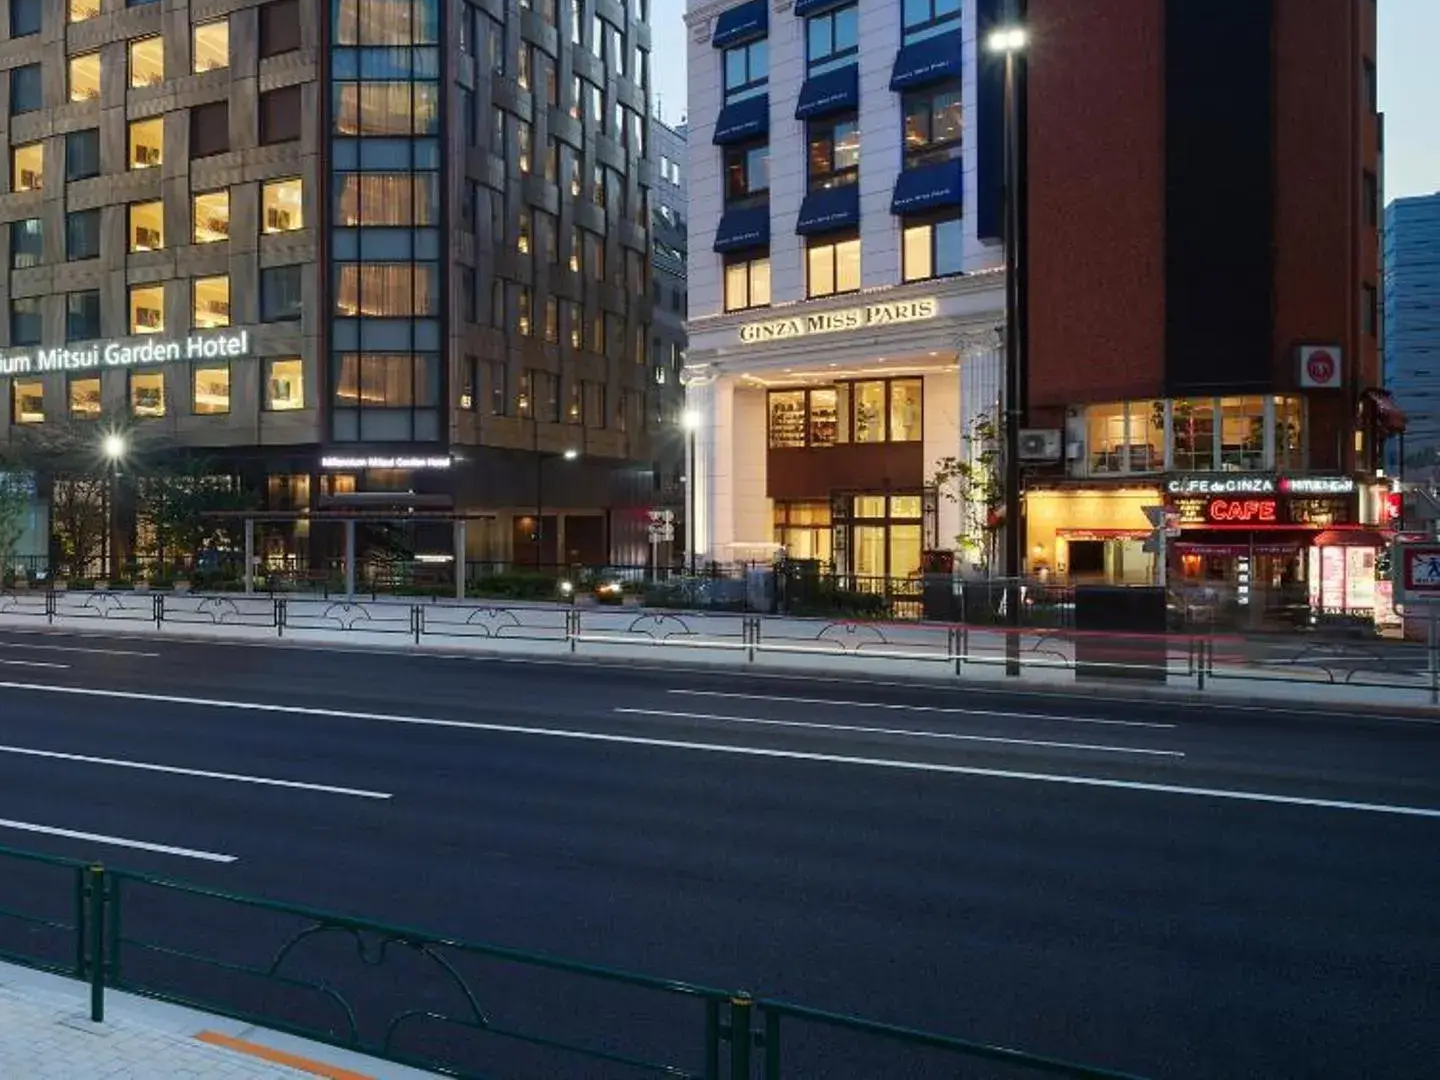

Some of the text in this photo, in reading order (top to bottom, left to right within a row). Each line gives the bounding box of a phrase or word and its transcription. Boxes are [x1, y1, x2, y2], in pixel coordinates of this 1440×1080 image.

[740, 300, 933, 342] GINZA MISS PARIS
[38, 345, 99, 371] Mitsui
[104, 338, 180, 366] Garden
[187, 329, 248, 358] Hotel
[1226, 479, 1274, 491] GINZA
[1211, 500, 1276, 520] CAFE
